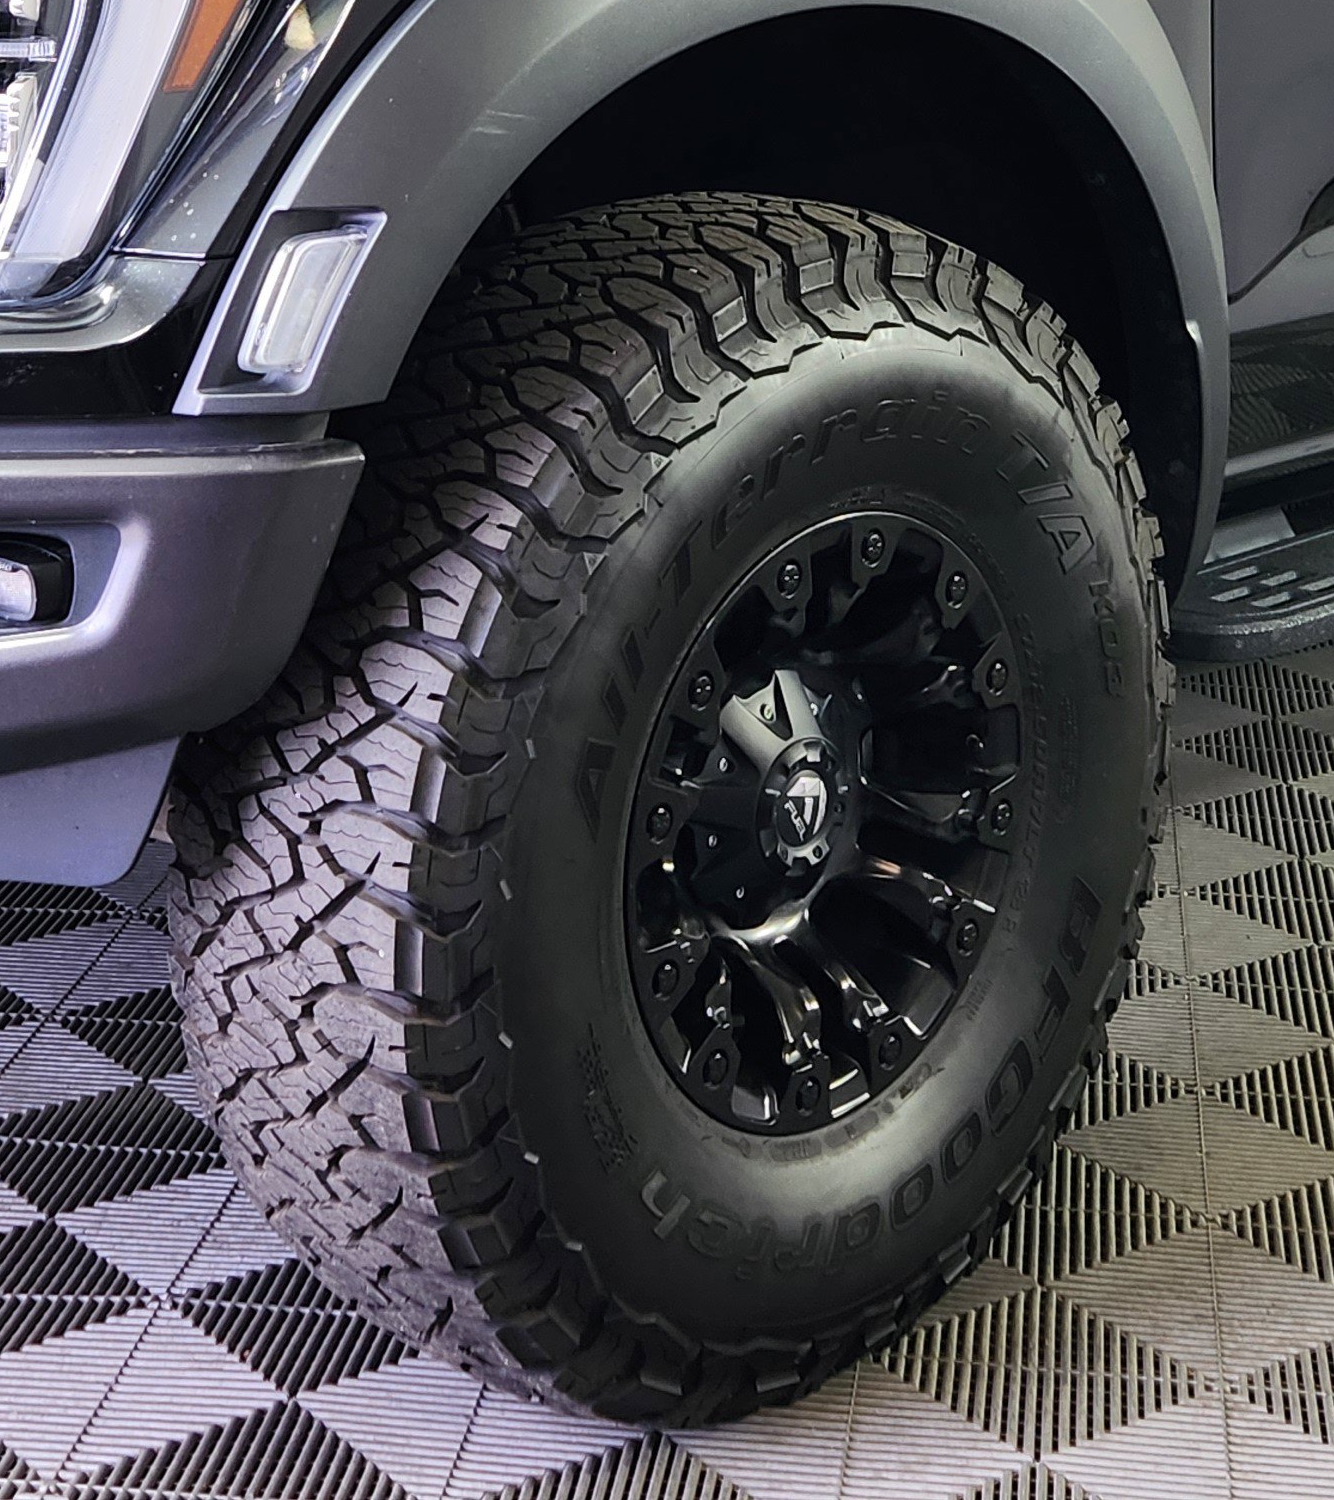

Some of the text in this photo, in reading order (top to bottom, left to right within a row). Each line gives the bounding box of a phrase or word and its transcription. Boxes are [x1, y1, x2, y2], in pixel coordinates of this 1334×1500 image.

[576, 390, 992, 844] All-Terrain
[995, 430, 1095, 576] T/A
[1088, 579, 1127, 698] KO3
[640, 875, 1103, 1272] BFGoodrich
